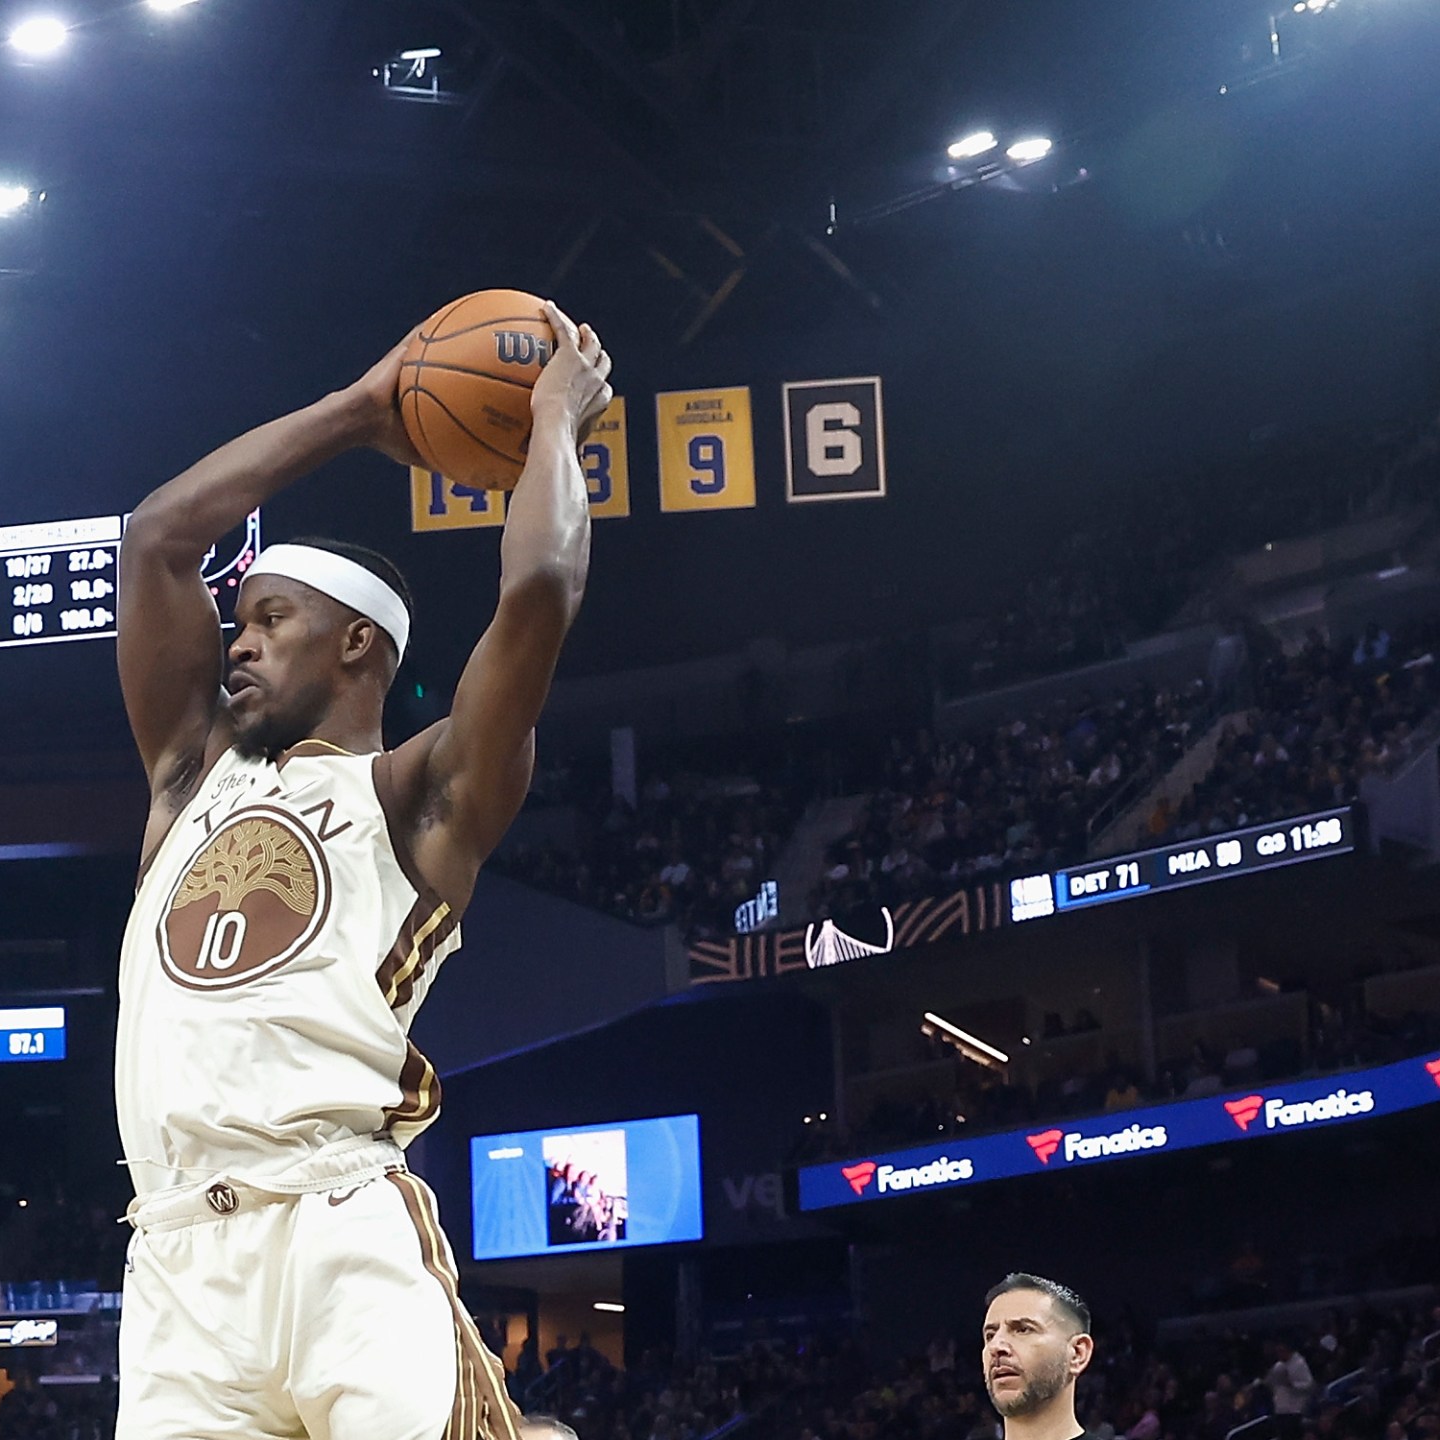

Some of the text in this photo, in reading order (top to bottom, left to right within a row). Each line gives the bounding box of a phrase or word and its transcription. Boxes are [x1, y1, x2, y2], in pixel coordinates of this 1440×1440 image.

[806, 402, 862, 477] 6
[687, 434, 726, 496] 9
[1070, 870, 1109, 896] DET
[1115, 862, 1140, 888] 71
[194, 911, 248, 970] 10
[1264, 1088, 1374, 1128] Fanatics
[1064, 1122, 1167, 1161] Fanatics
[876, 1153, 973, 1192] Fanatics
